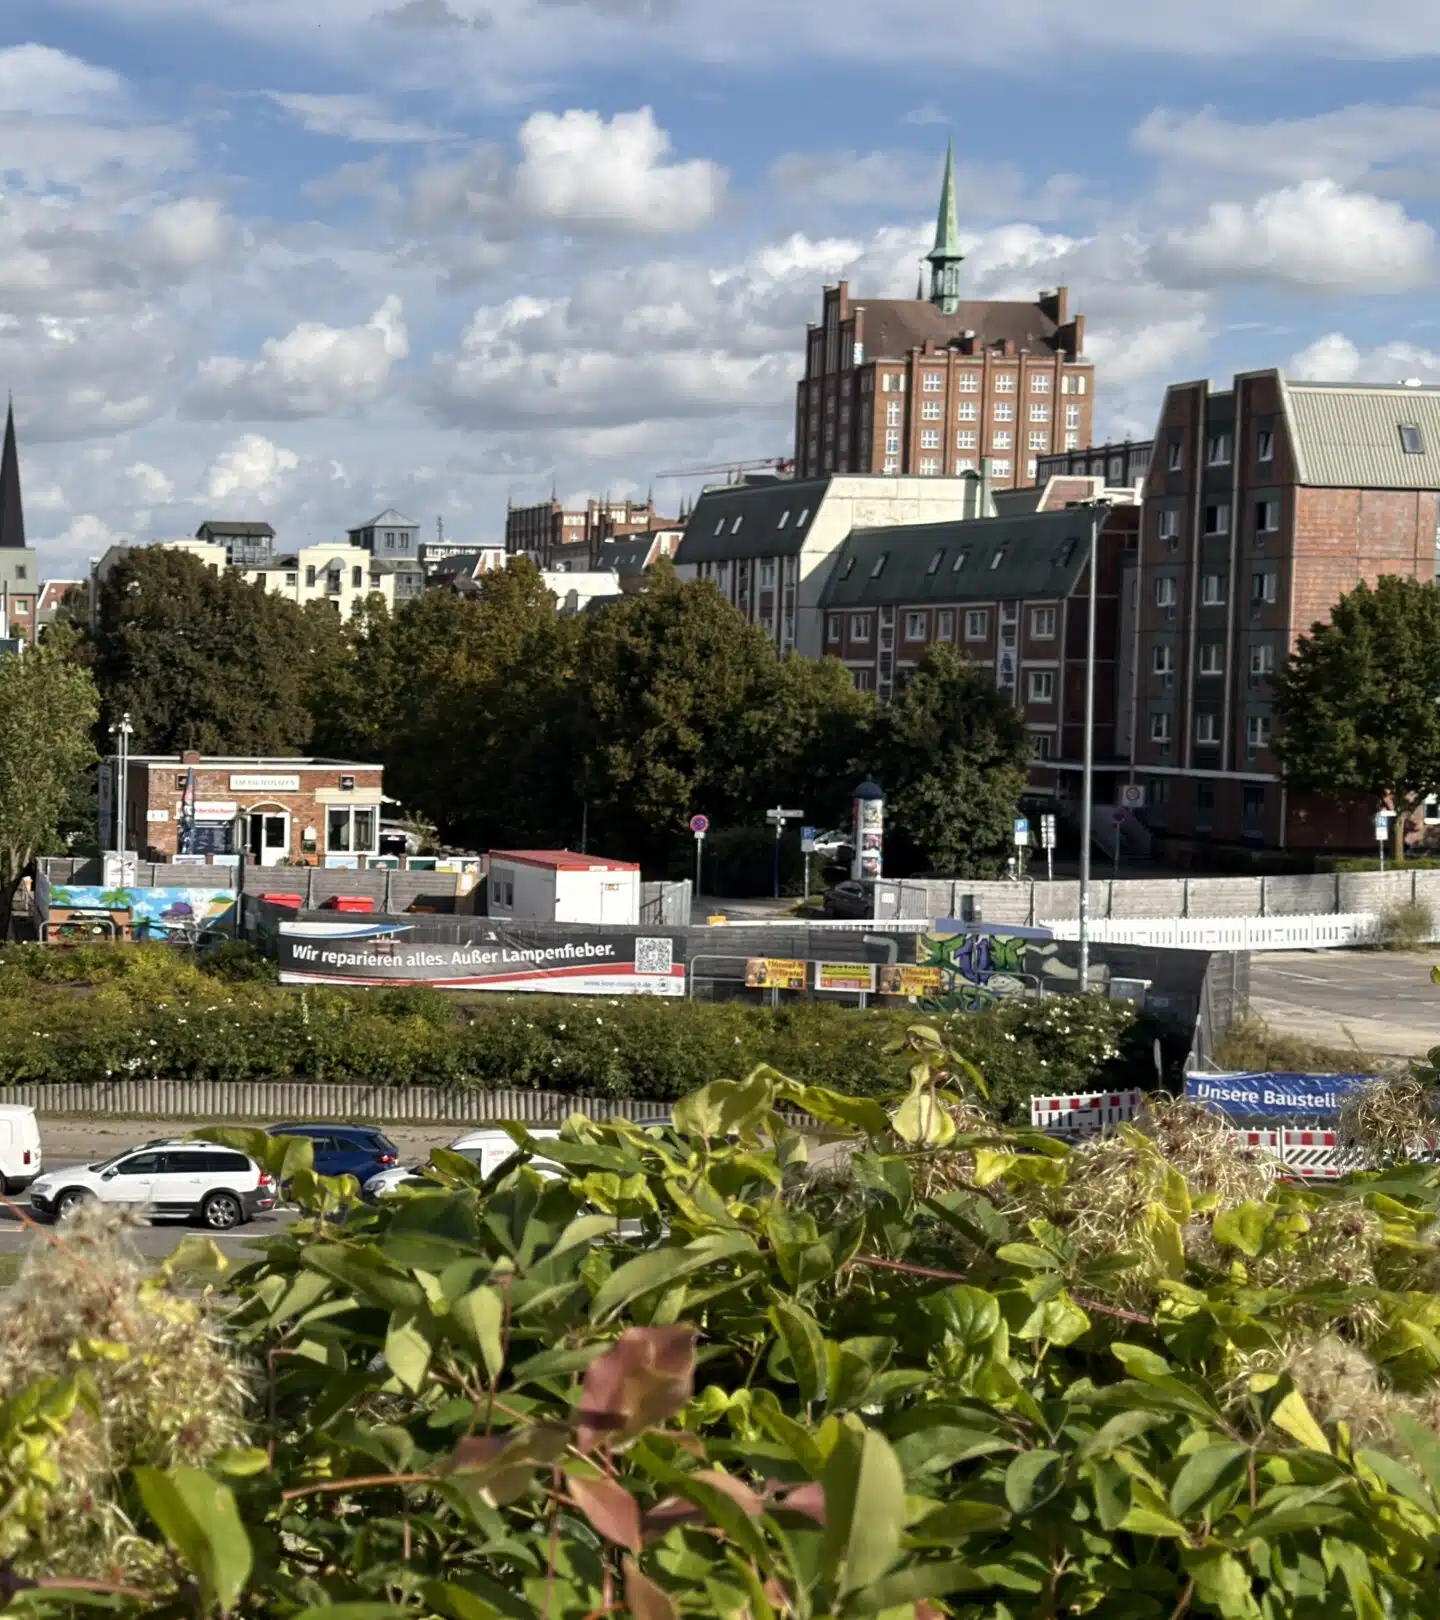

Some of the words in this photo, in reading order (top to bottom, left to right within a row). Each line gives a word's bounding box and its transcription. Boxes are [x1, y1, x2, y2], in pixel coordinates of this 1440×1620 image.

[292, 944, 319, 960] Wir
[321, 950, 403, 967] reparieren
[406, 951, 448, 966] alles.
[451, 950, 498, 965] Außer
[502, 942, 616, 963] Lampenfieber.
[1197, 1083, 1260, 1104] Unsere
[1263, 1090, 1338, 1108] Baustell
